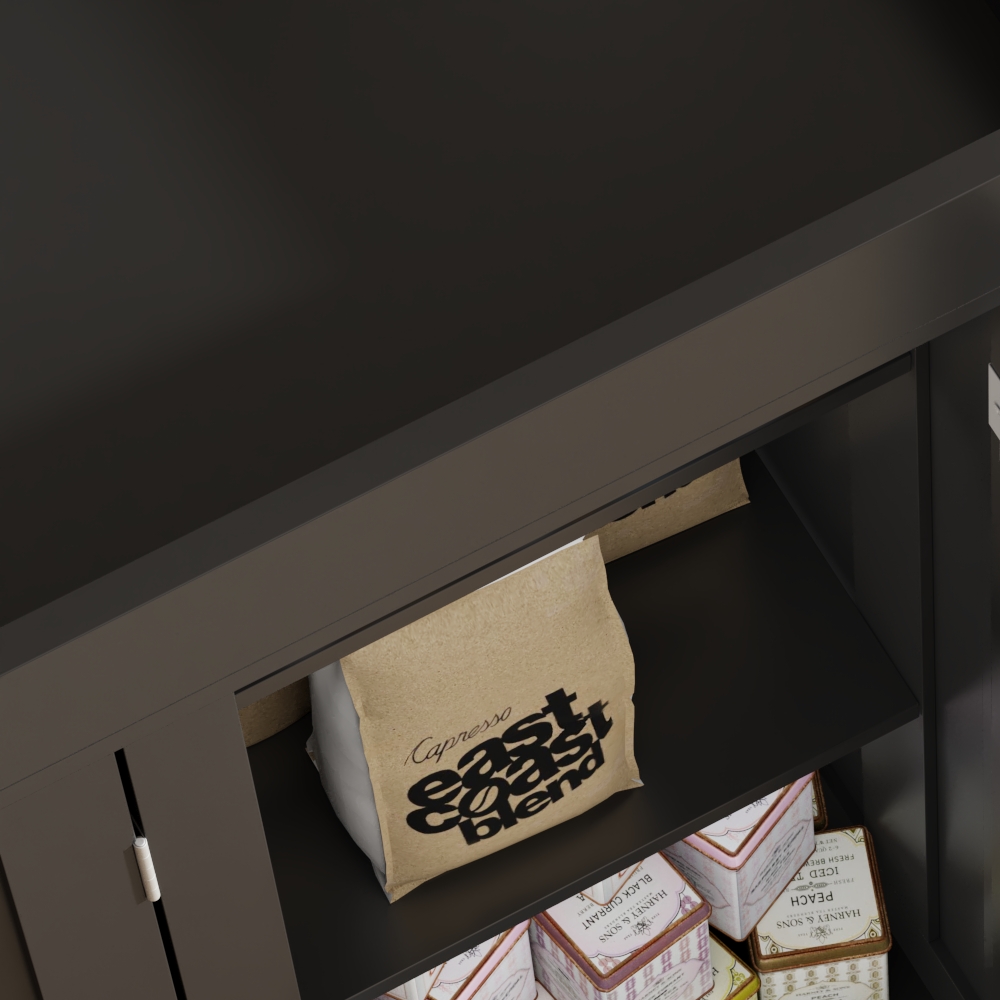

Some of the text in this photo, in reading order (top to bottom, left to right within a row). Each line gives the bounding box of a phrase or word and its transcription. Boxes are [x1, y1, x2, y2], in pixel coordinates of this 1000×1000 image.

[404, 706, 512, 766] Capresso
[407, 687, 587, 807] east
[406, 699, 614, 834] coast
[458, 741, 605, 846] blend
[808, 865, 838, 878] ICED
[828, 852, 854, 863] FRESH
[582, 872, 653, 931] BLACK CURRANT
[597, 888, 667, 943] HARNEY & SONS
[775, 907, 861, 929] HARNEY & SONS
[789, 889, 834, 907] PEACH
